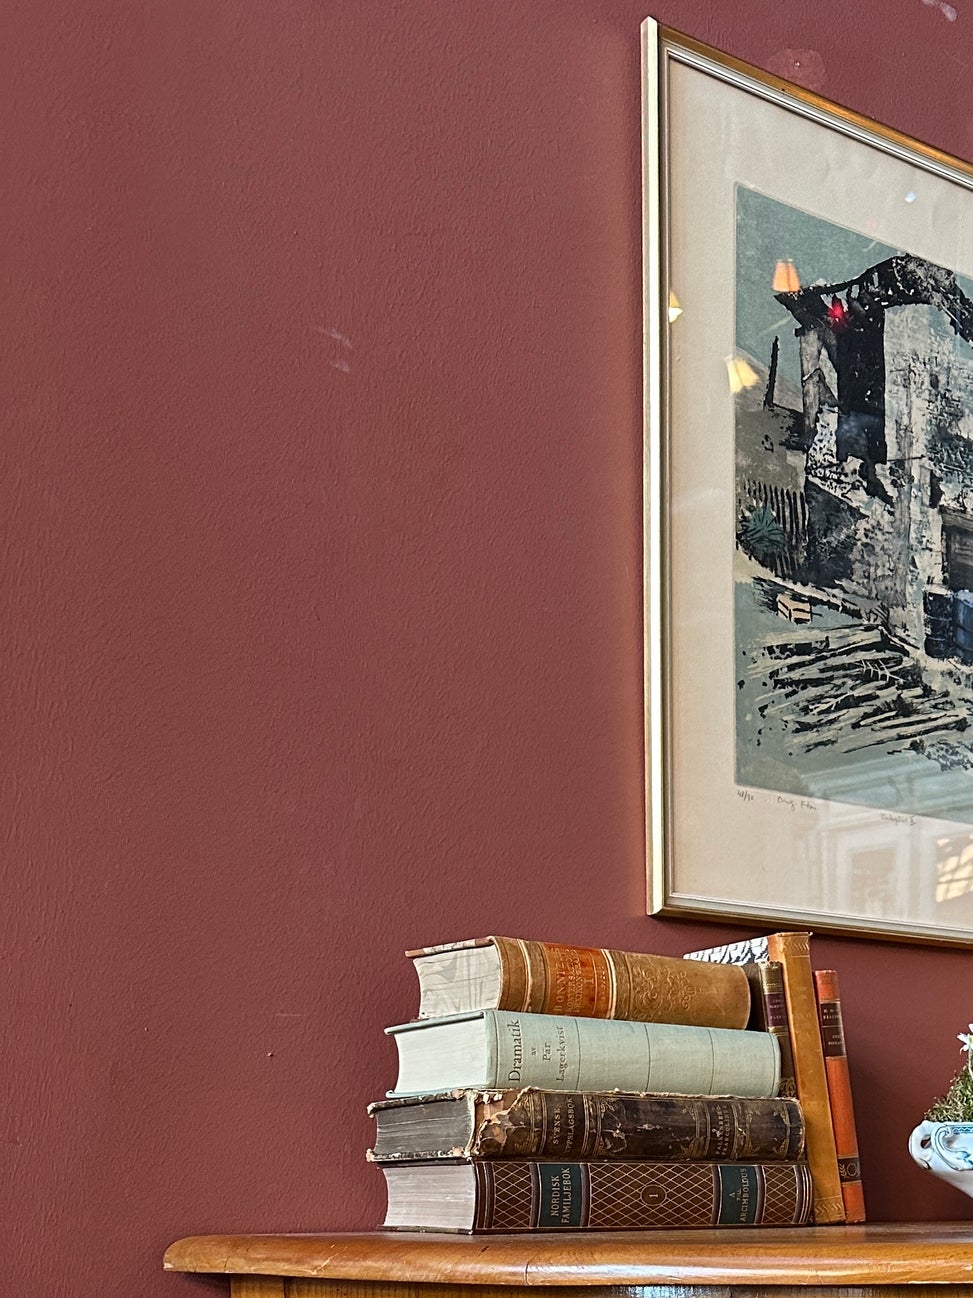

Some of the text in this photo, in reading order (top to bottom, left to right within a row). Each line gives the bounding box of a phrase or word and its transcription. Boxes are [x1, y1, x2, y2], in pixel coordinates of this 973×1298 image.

[507, 1019, 521, 1082] Dramatik
[531, 1046, 537, 1056] av
[555, 1026, 568, 1082] Lagerkvist
[565, 1097, 575, 1152] PPSLAGSBOK
[550, 1175, 560, 1217] NORDISK
[561, 1167, 572, 1223] FAMILJEBOK
[740, 1168, 750, 1222] ARCIMBOLDUS
